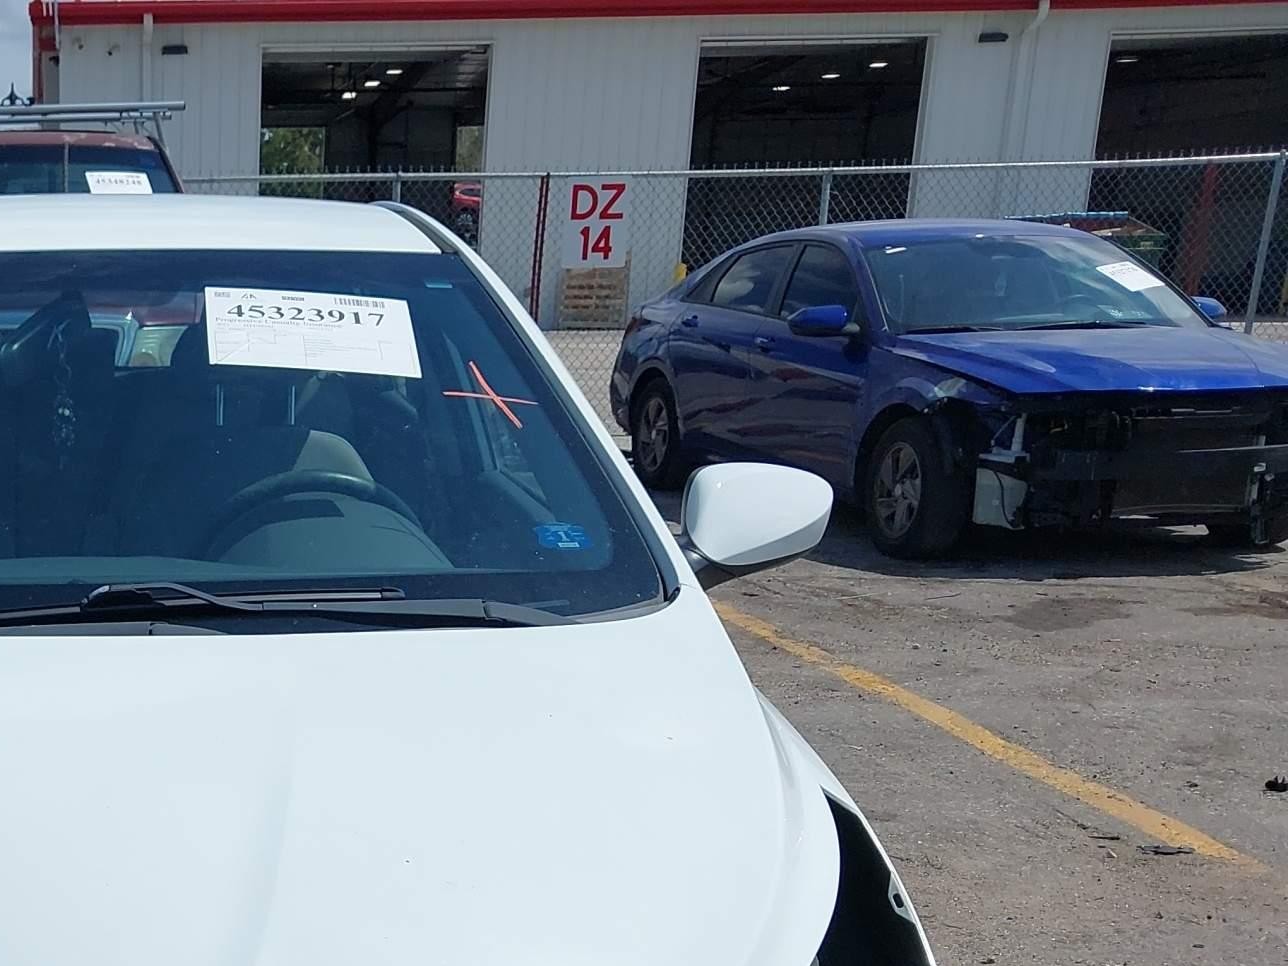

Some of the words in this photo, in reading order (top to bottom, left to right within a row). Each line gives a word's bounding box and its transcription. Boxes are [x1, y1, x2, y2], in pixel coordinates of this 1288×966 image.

[571, 184, 626, 220] DZ
[580, 225, 612, 260] 14
[227, 304, 385, 327] 45323917
